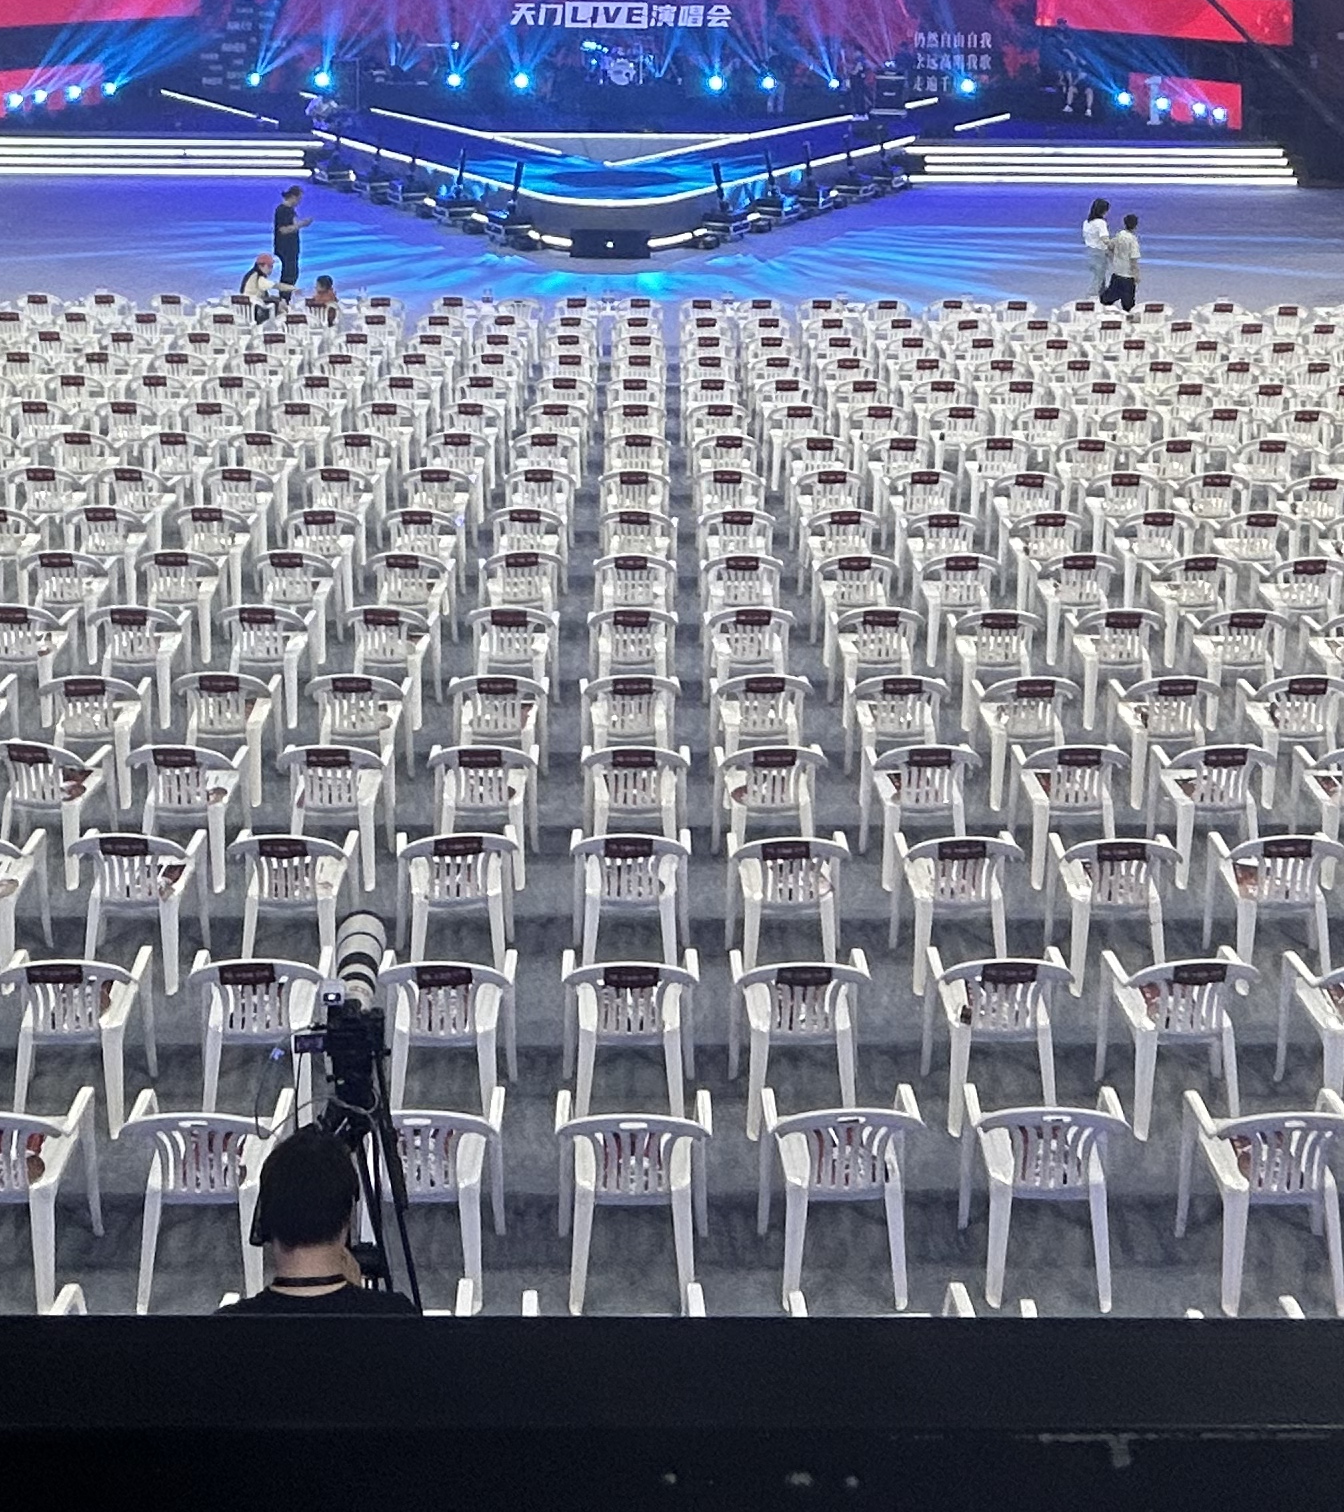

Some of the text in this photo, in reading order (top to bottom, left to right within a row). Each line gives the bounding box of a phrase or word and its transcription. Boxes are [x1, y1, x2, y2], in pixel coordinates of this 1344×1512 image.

[510, 1, 733, 28] 天门LIVE演唱会
[914, 31, 992, 48] 仍然自由自我
